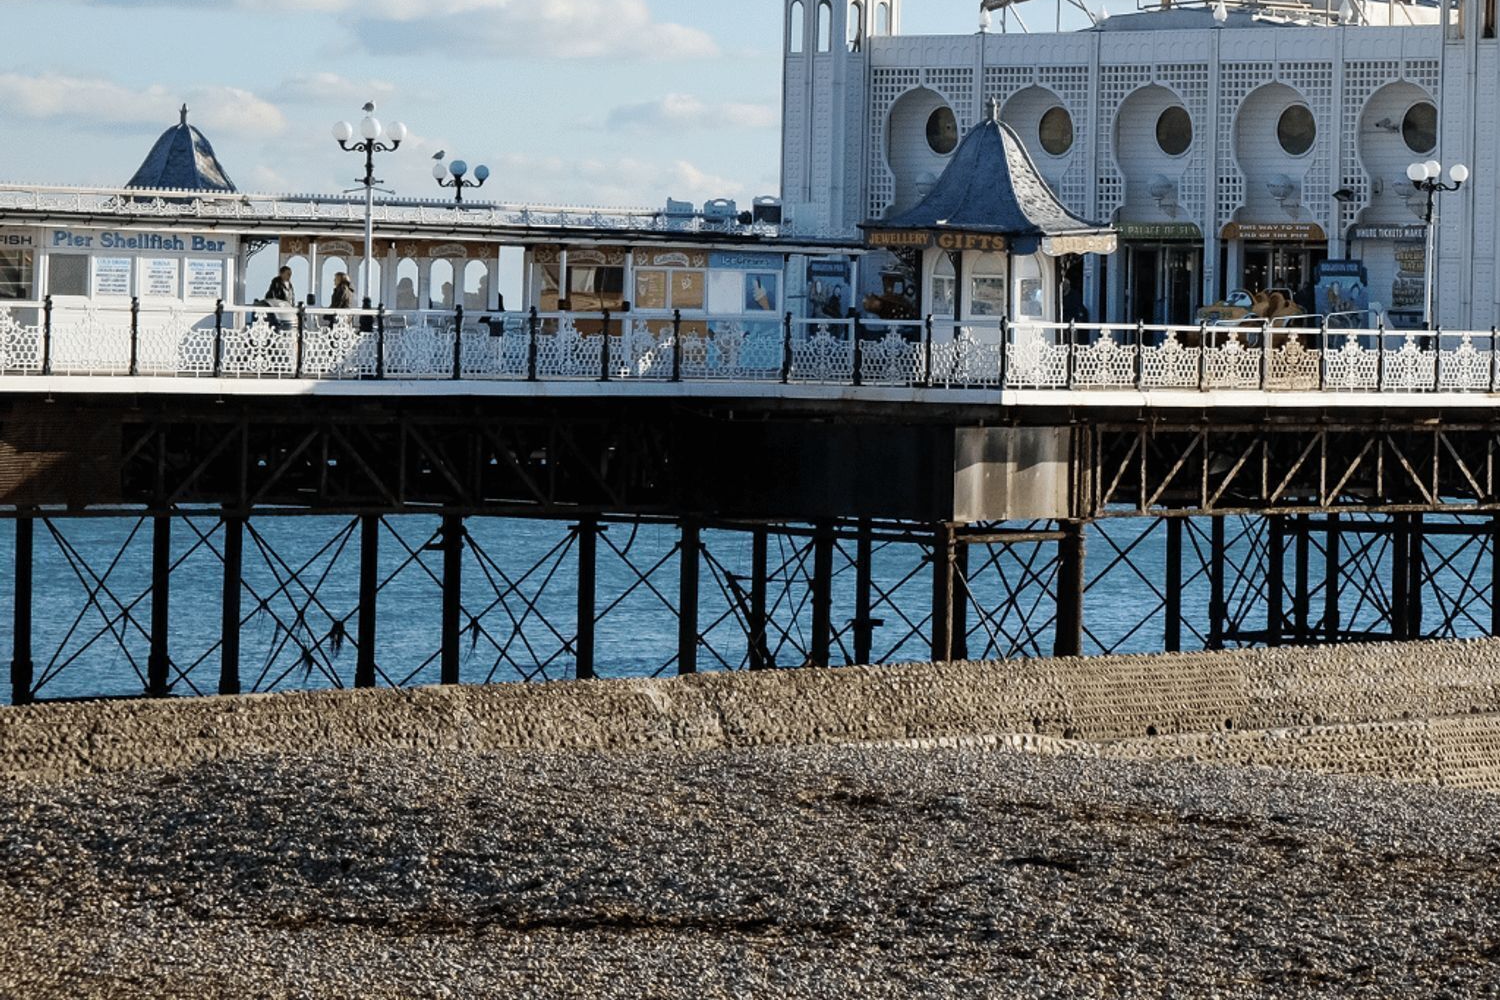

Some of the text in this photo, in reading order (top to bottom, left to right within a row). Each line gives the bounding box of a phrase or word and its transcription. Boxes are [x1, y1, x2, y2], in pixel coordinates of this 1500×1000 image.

[53, 230, 226, 252] Pier Shellfish Bar
[868, 231, 1006, 250] JEWELLERY GIFTS
[1379, 228, 1403, 238] TICKETS
[1404, 228, 1423, 238] MAKE
